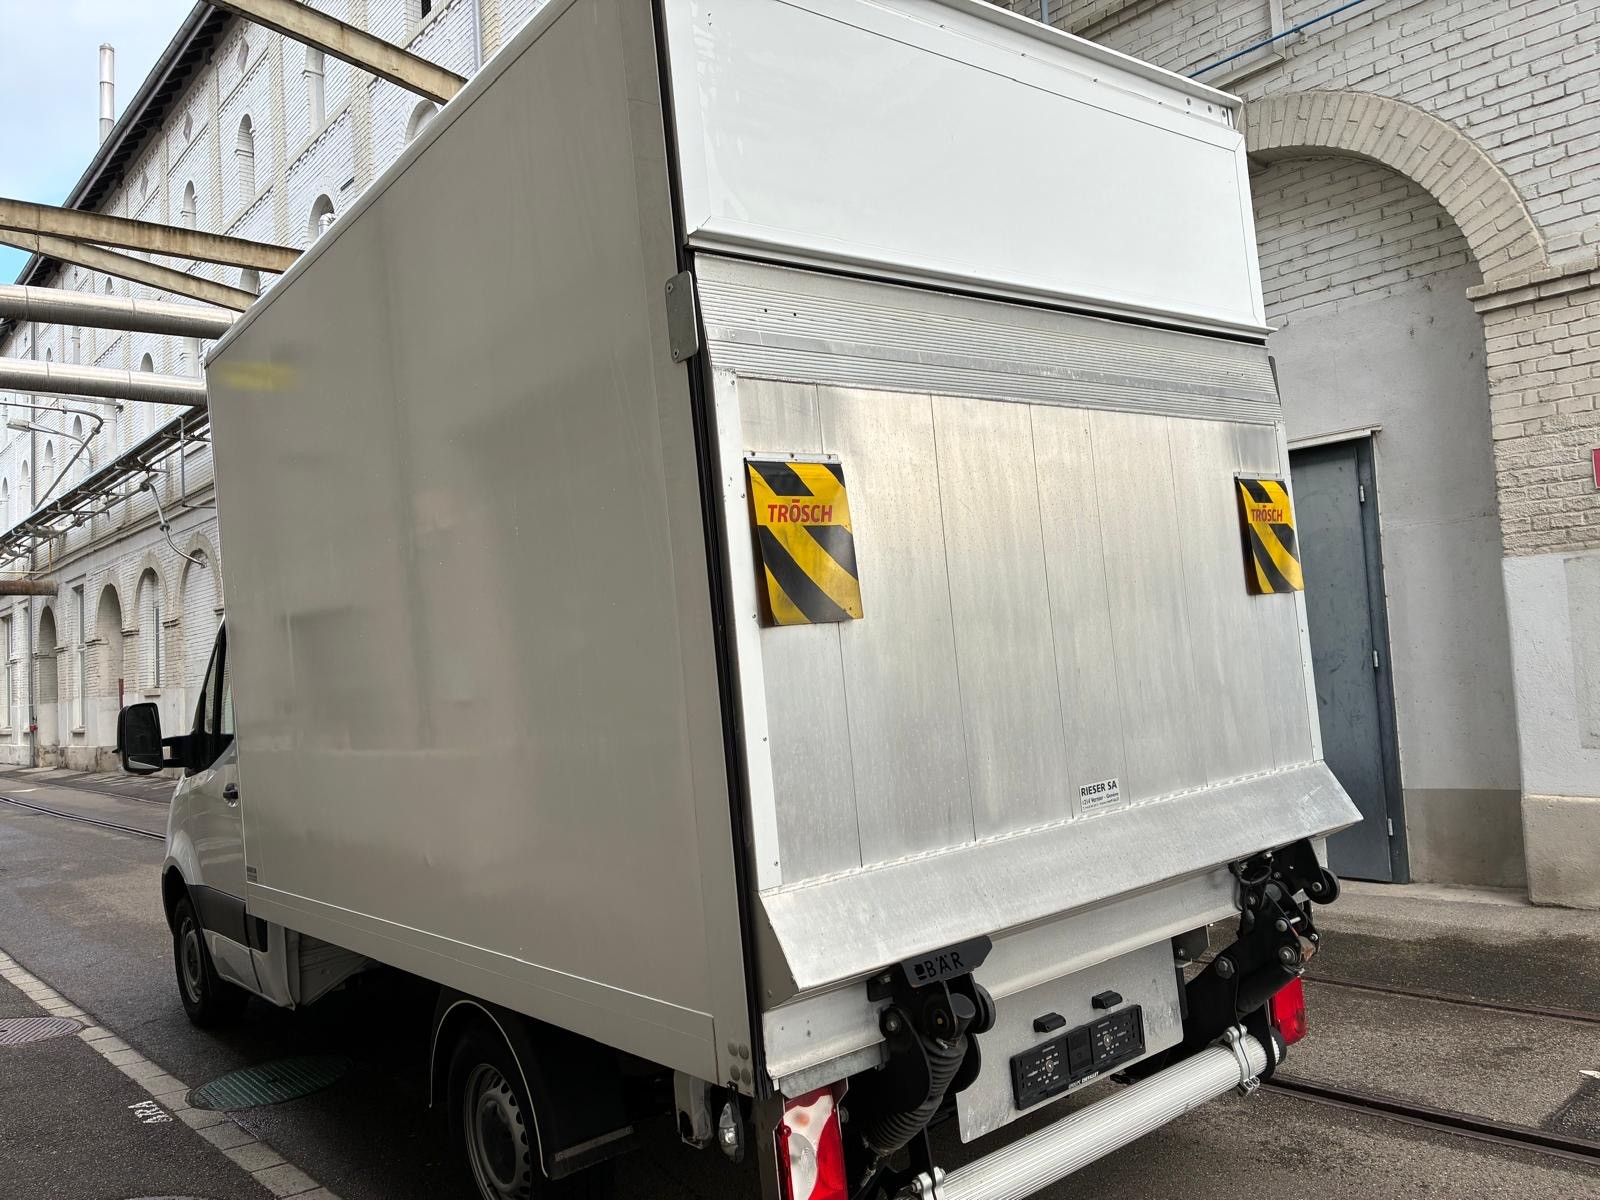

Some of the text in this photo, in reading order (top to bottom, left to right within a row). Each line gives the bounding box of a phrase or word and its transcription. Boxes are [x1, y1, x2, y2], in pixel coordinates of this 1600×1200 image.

[767, 498, 833, 523] TRÖSCH
[1251, 504, 1283, 522] TRÖSCH
[1081, 781, 1117, 797] RIESER SA
[924, 951, 965, 978] BÄR
